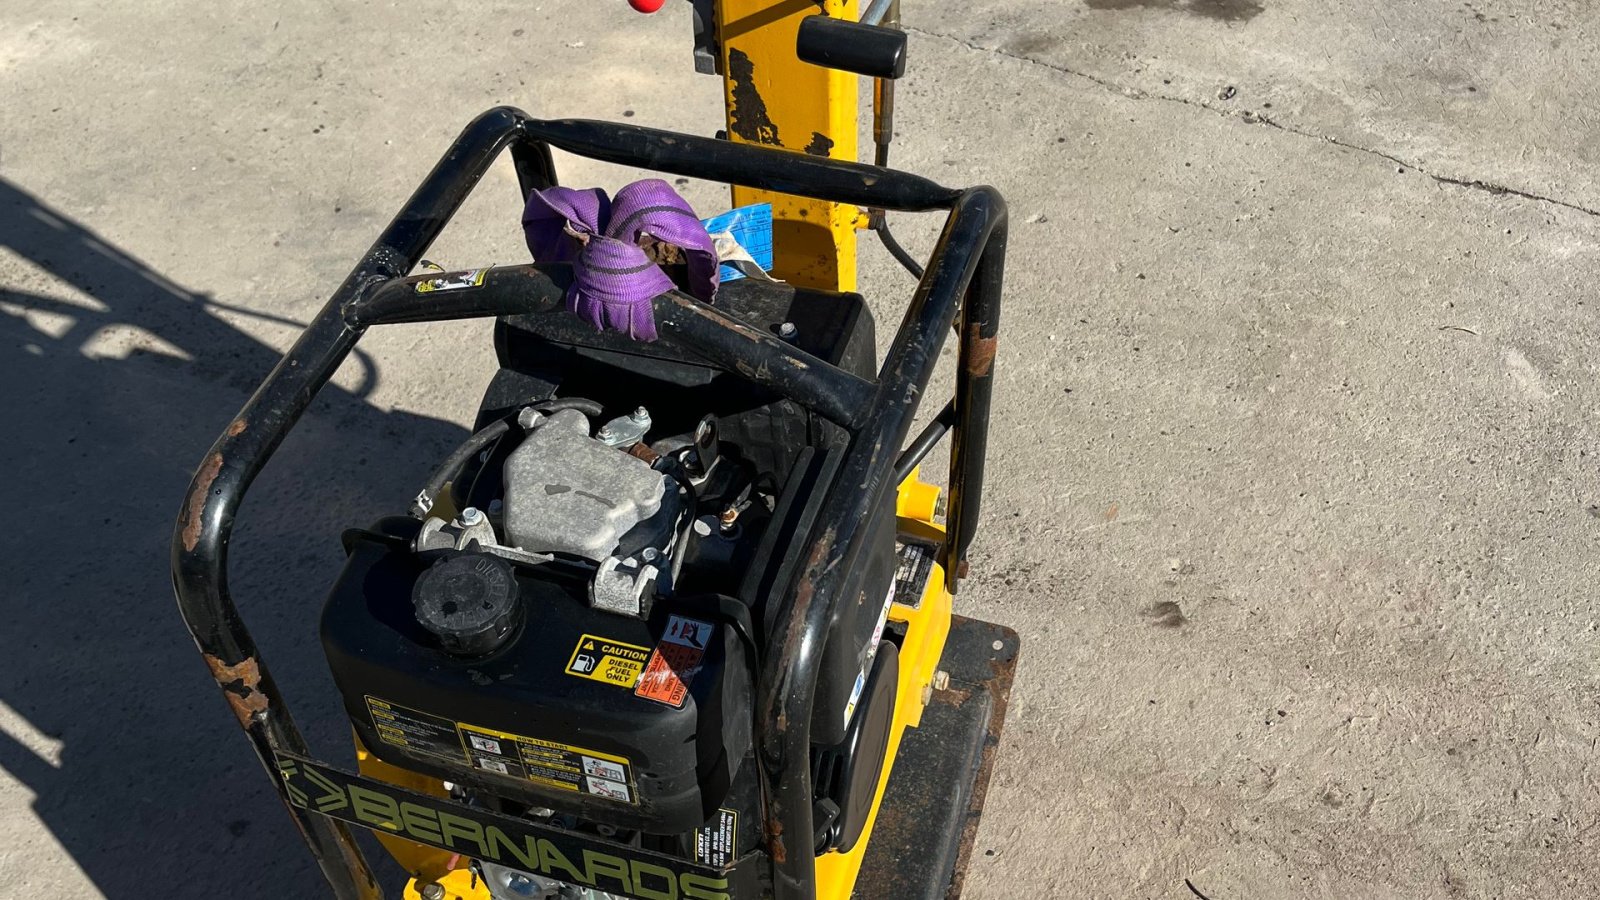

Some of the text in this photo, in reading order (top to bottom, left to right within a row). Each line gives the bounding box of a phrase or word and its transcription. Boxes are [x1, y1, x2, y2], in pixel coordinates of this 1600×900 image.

[602, 644, 648, 660] CAUTION
[609, 658, 638, 670] DIESEL
[606, 671, 630, 682] ONLY
[609, 666, 632, 676] FUEL
[347, 784, 730, 900] BERNARDS
